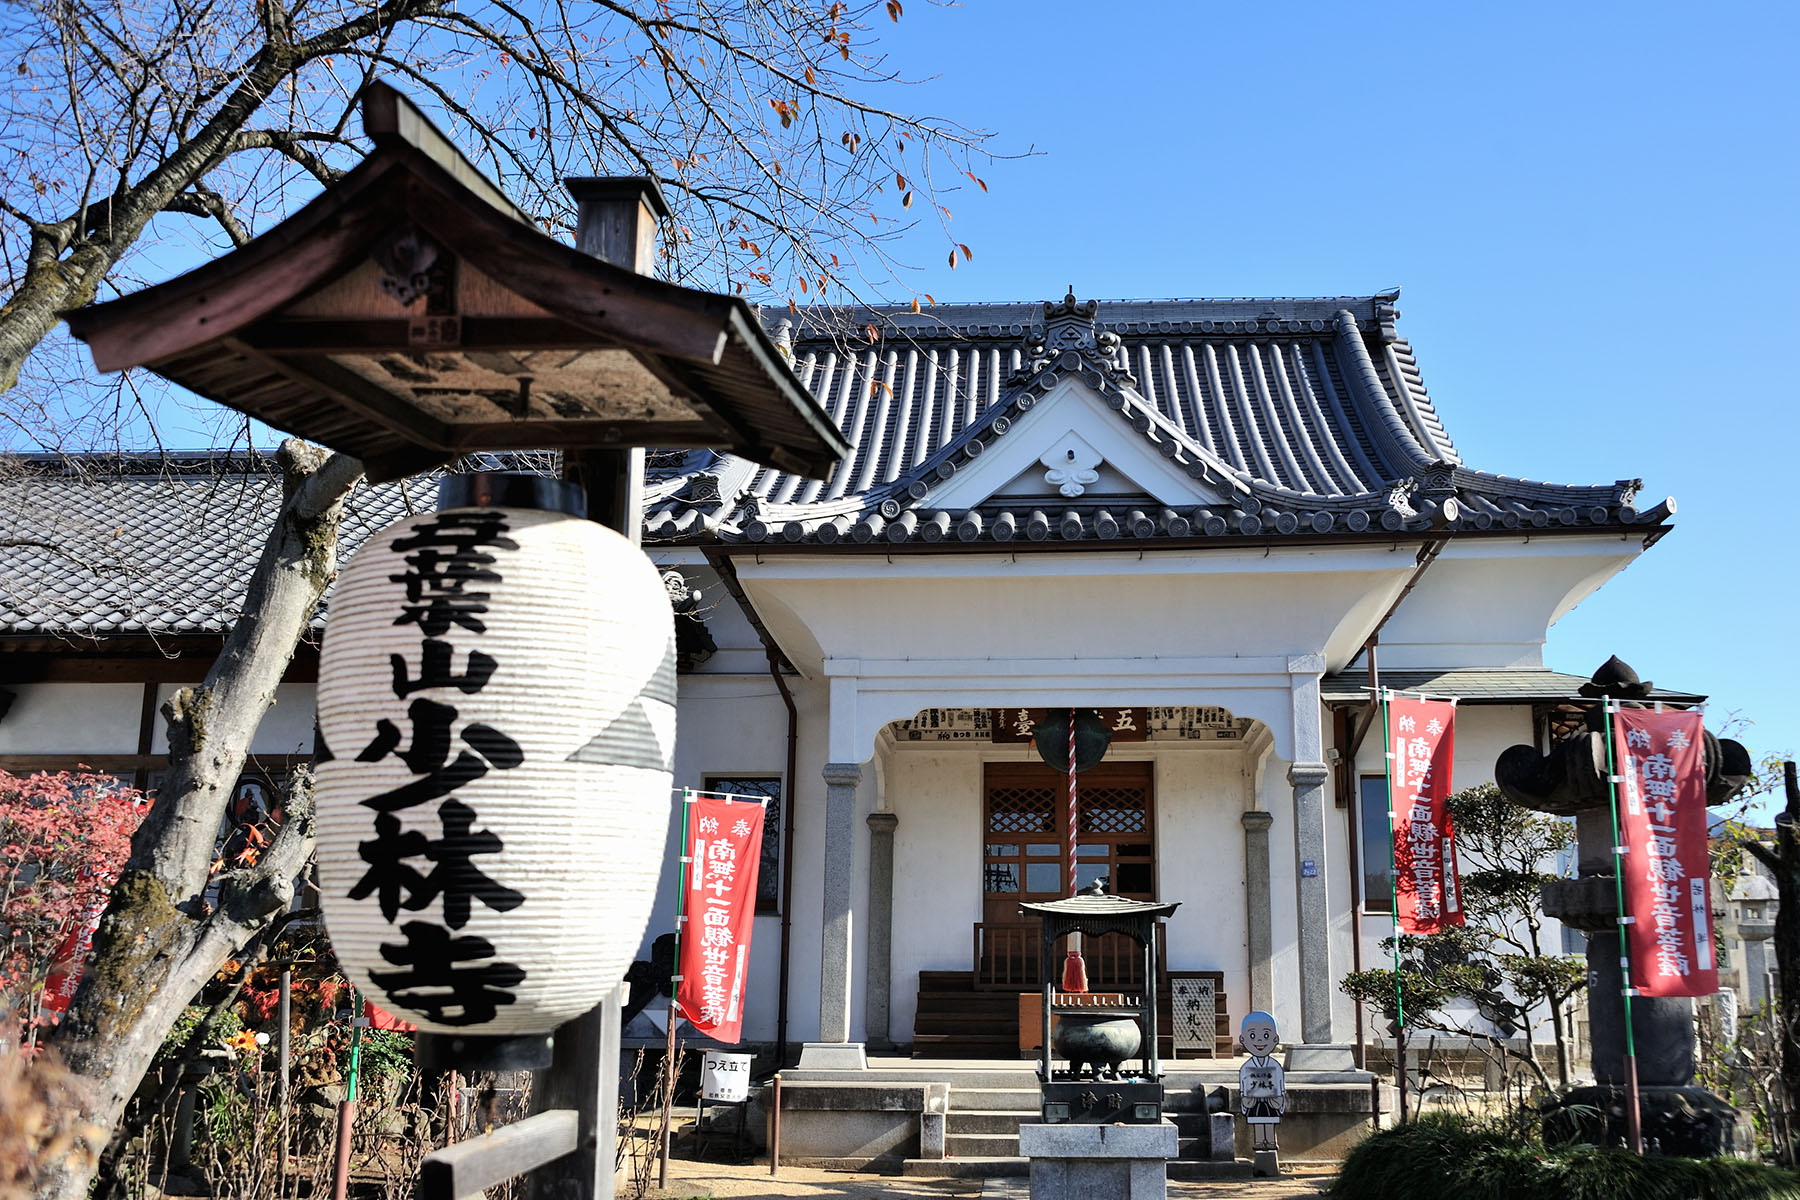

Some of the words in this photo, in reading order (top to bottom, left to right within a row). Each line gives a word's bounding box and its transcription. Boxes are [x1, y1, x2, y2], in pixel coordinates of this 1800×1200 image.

[347, 511, 526, 1026] 五葉山少林寺
[707, 1060, 747, 1072] つえ立て
